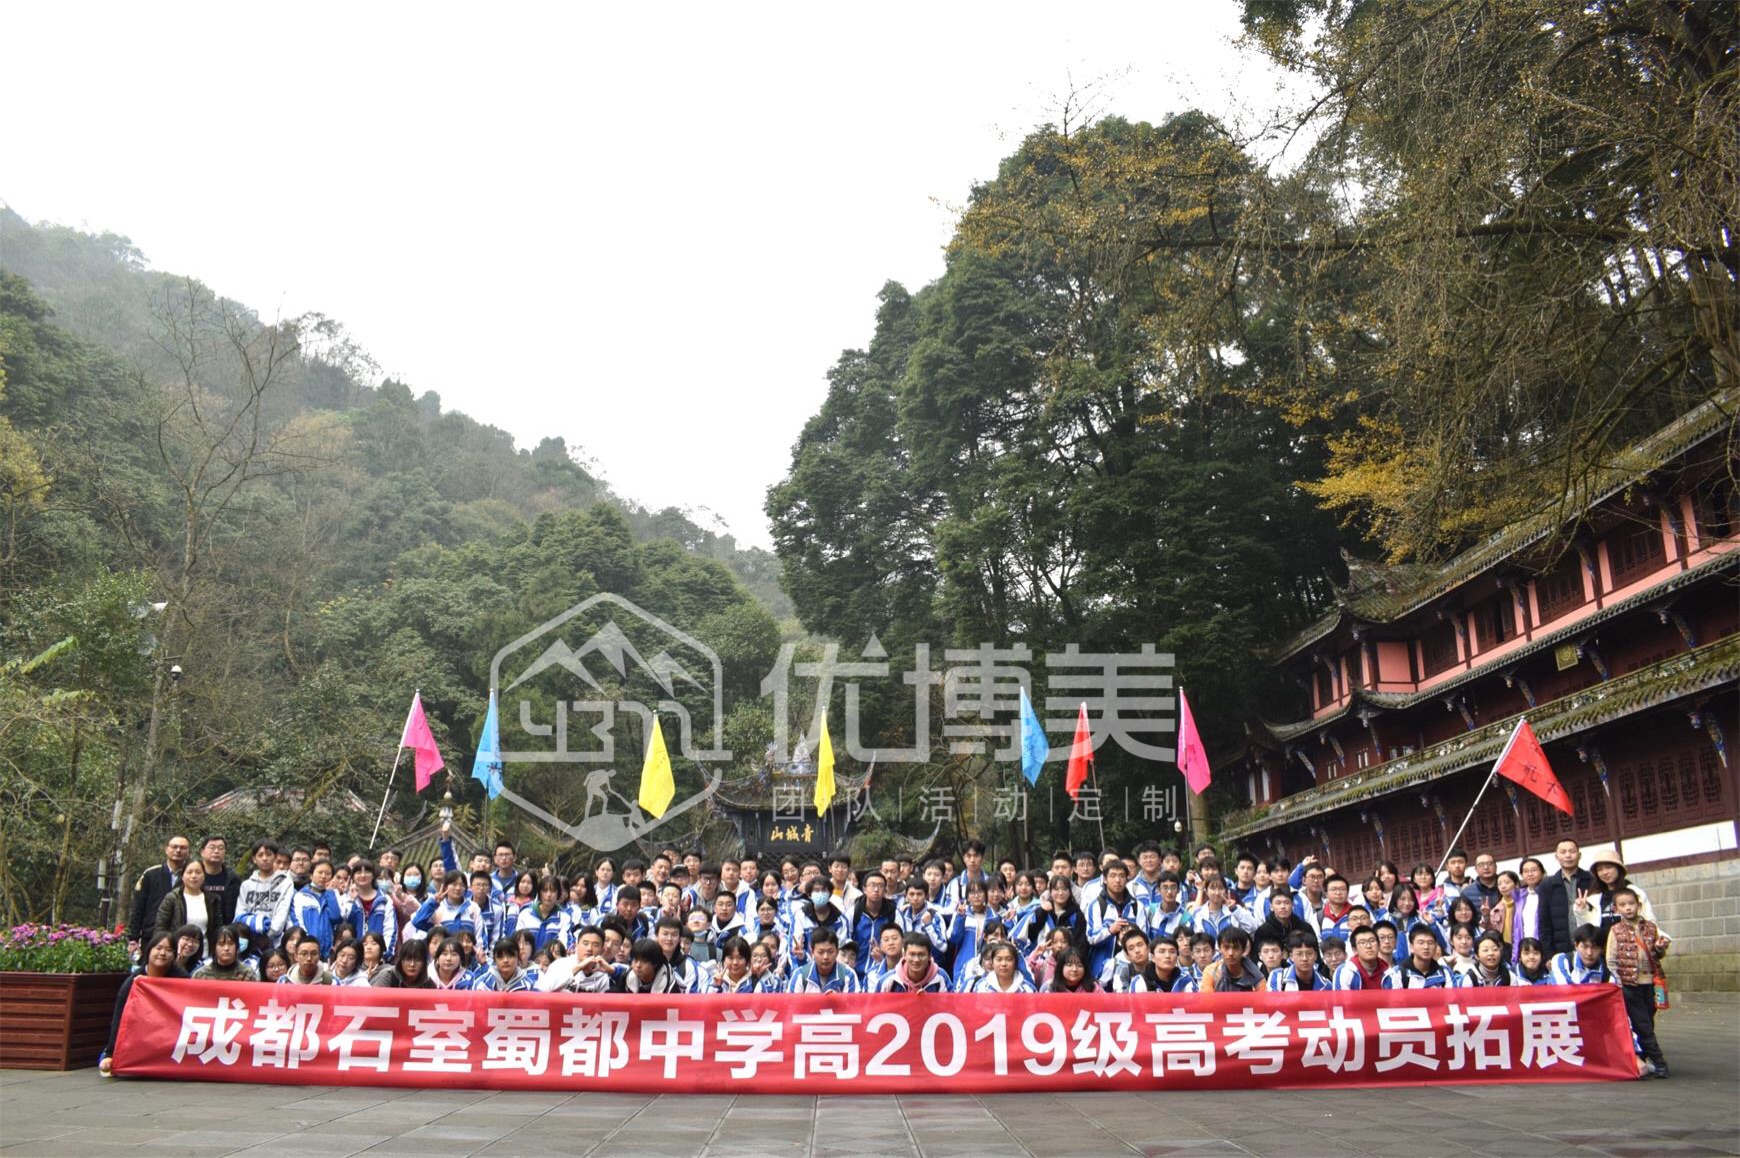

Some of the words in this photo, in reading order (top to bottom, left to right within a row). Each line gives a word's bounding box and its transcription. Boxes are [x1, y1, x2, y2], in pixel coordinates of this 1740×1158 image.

[770, 824, 814, 843] 青城山
[171, 997, 1585, 1081] 成都石室蜀都中学高2019级高考动员拓展
